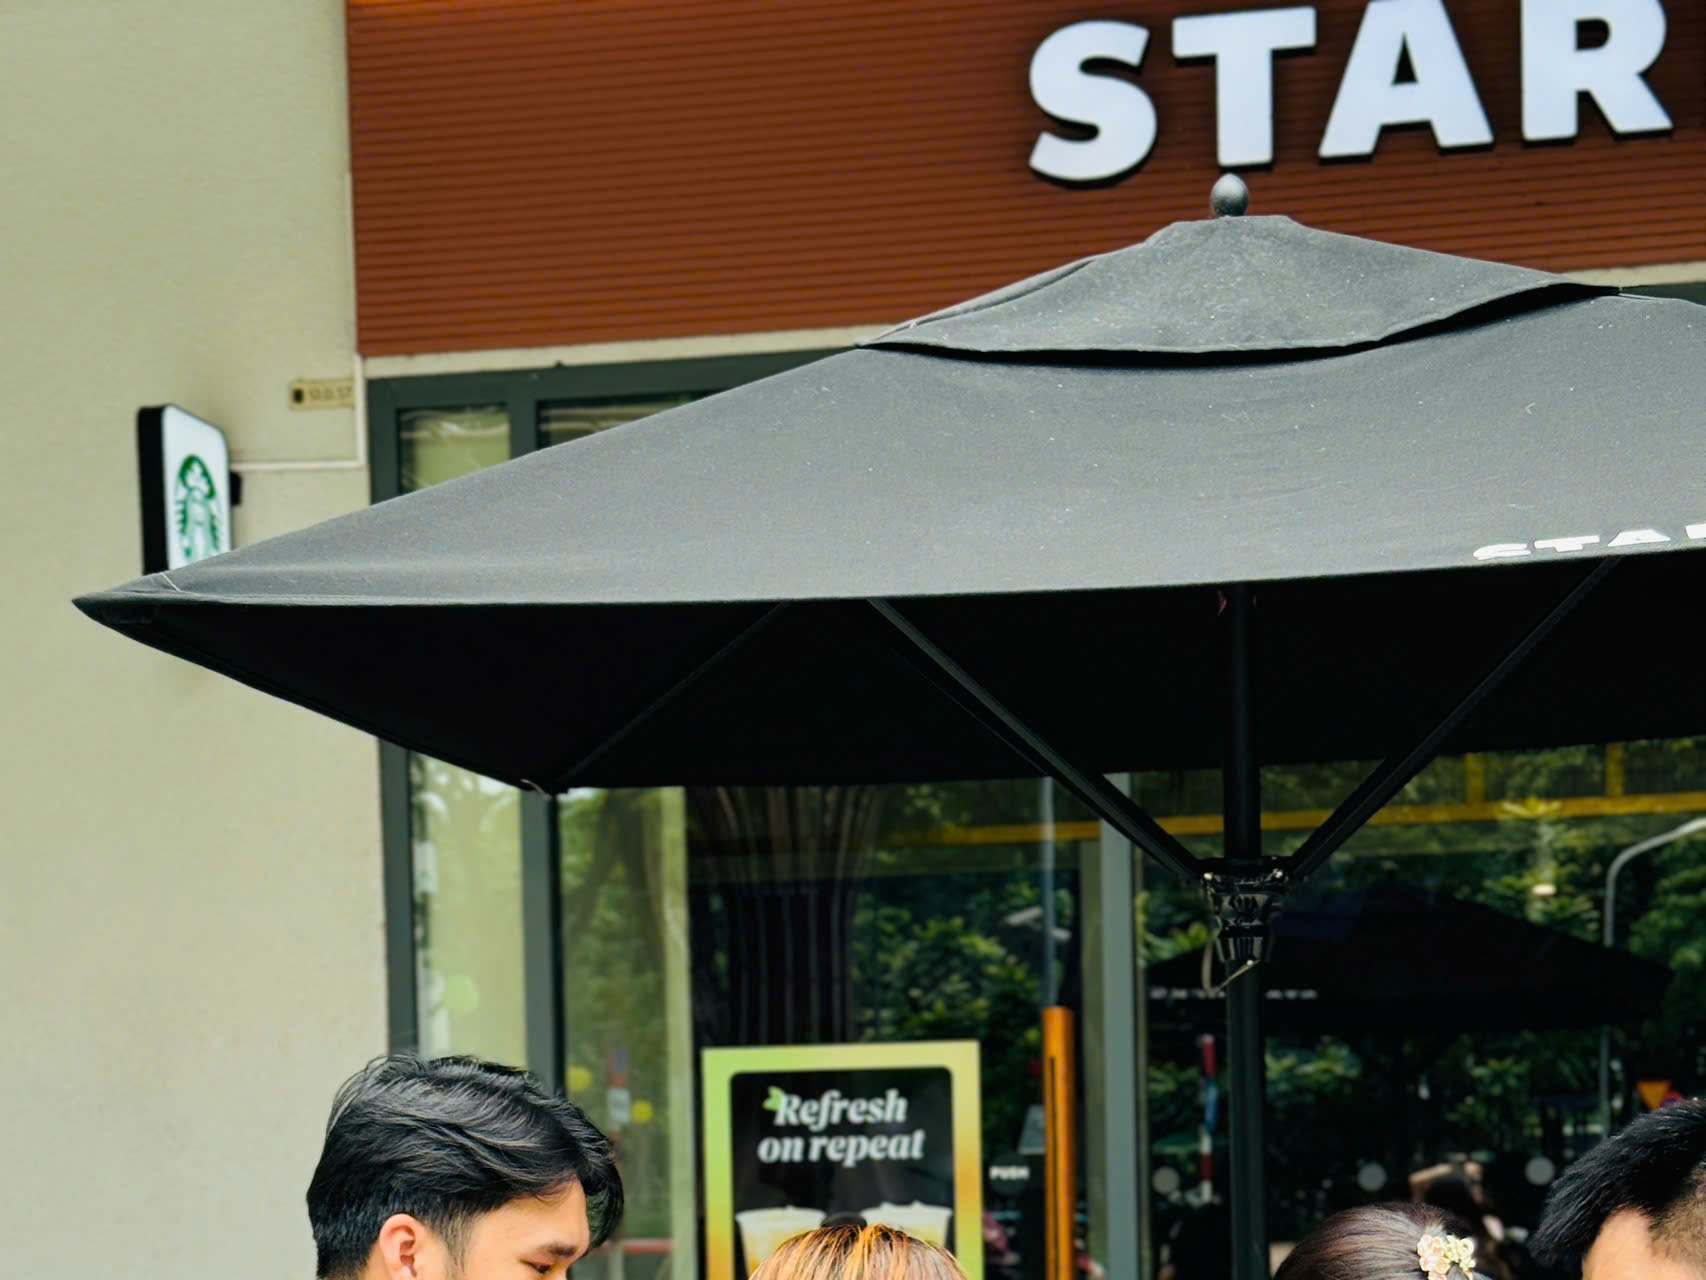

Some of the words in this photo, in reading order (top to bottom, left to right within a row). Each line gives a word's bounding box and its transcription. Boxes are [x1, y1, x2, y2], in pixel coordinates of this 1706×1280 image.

[1028, 0, 1674, 183] STAR
[773, 1088, 908, 1132] Refresh
[757, 1136, 804, 1163] on
[808, 1129, 926, 1168] repeat
